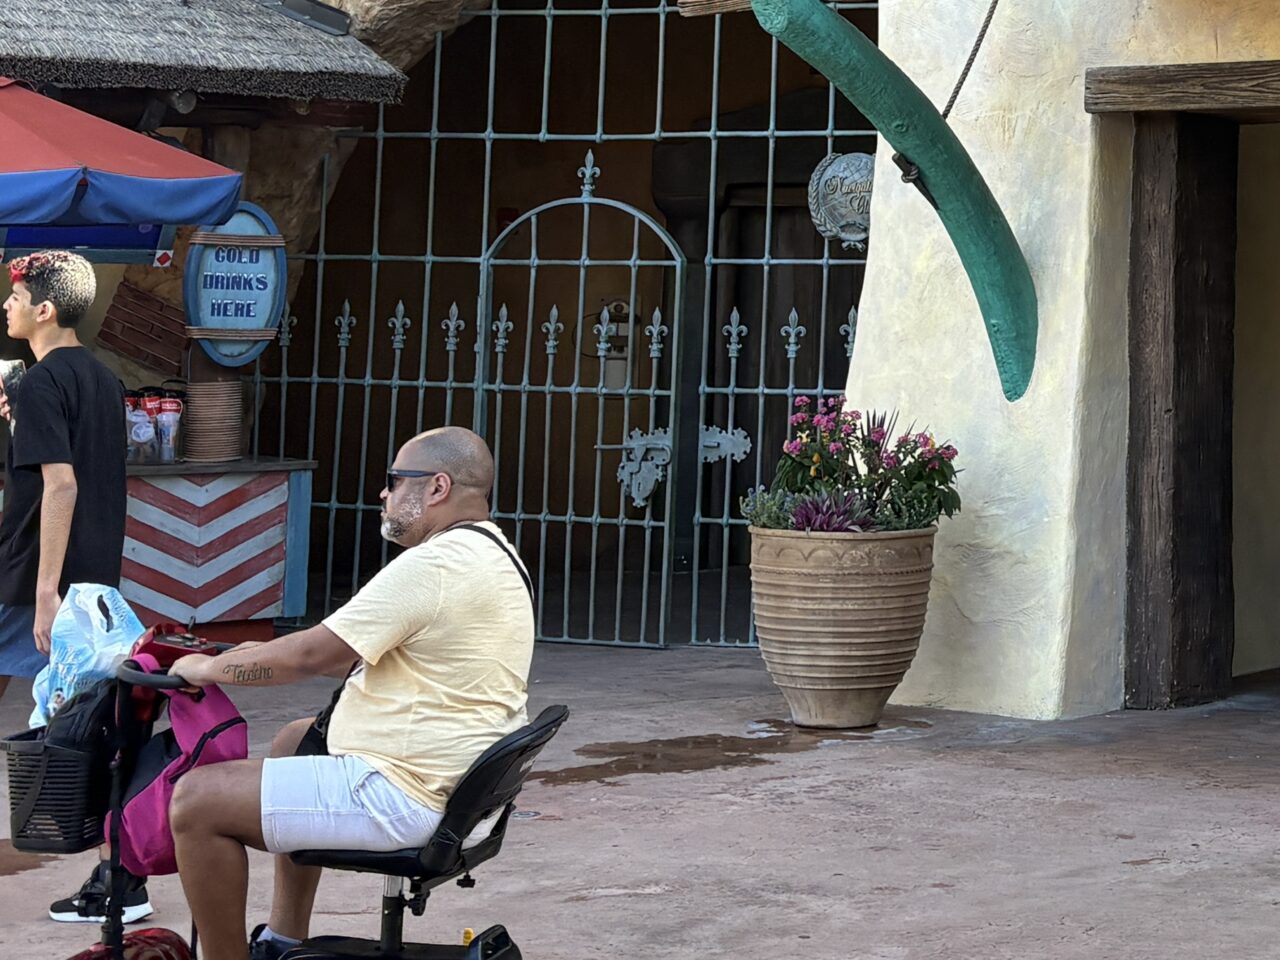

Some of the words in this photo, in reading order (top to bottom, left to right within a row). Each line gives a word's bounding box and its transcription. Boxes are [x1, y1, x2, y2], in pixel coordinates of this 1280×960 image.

[215, 246, 260, 263] COLD
[203, 272, 268, 291] DRINKS
[210, 299, 257, 318] HERE
